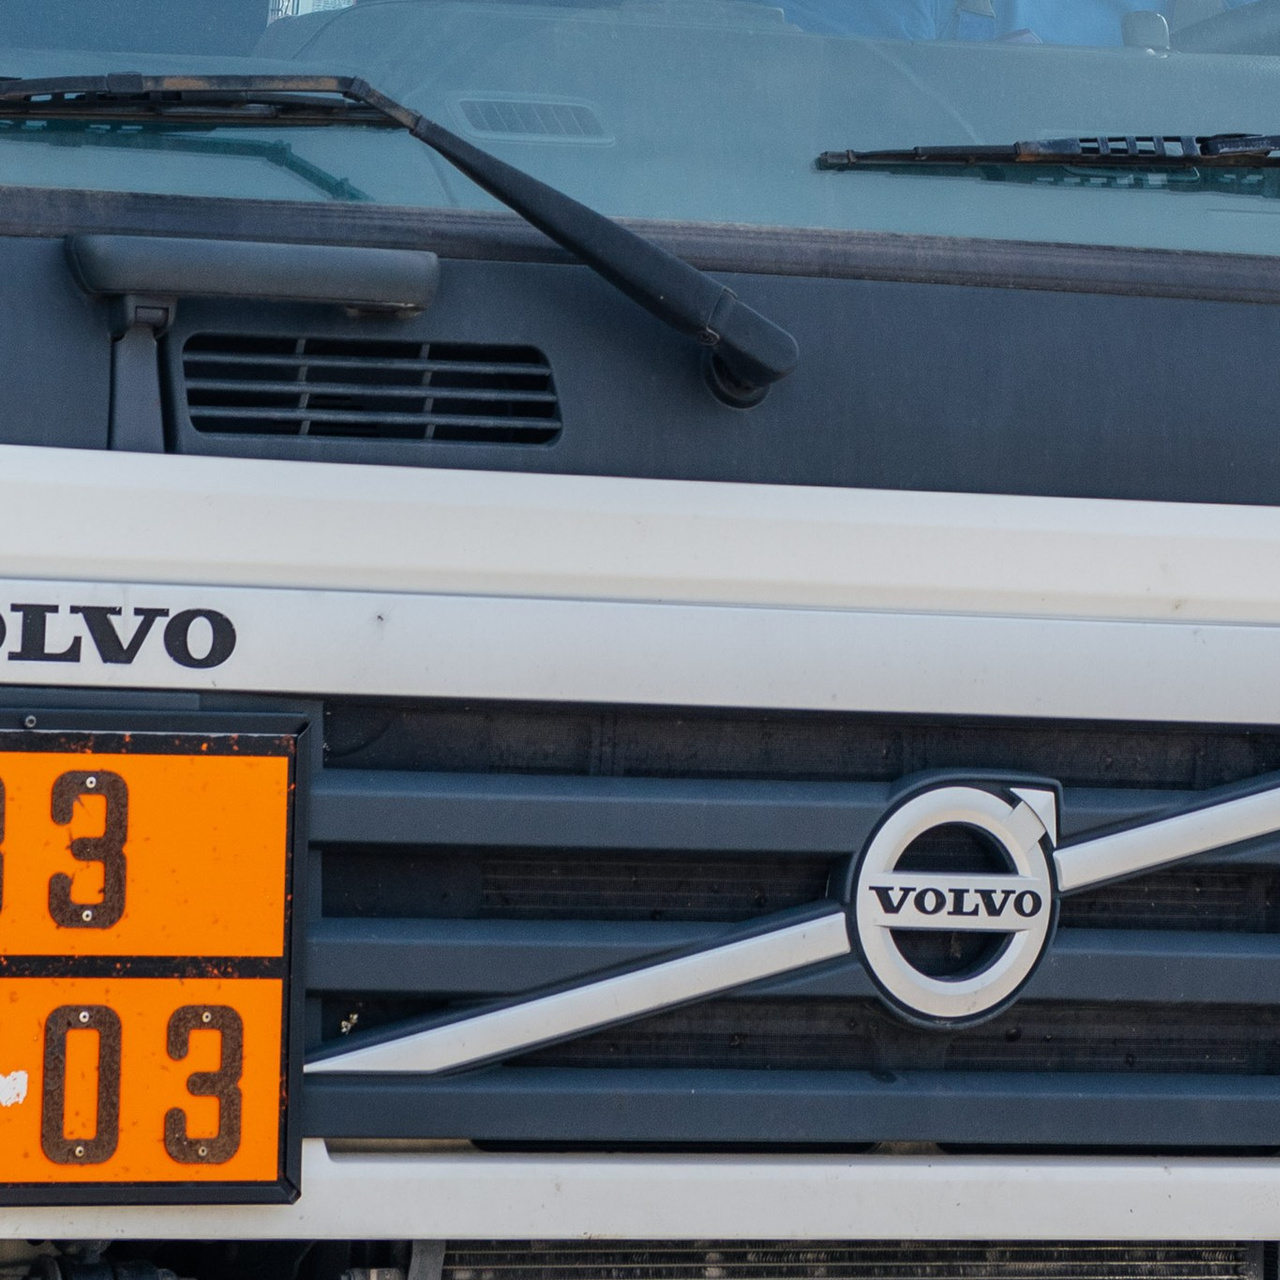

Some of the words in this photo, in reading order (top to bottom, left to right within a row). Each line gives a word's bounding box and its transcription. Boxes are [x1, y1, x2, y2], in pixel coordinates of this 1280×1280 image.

[0, 603, 237, 669] LVO
[0, 770, 129, 929] 3
[868, 886, 1042, 918] VOLVO
[41, 1004, 244, 1164] 03
